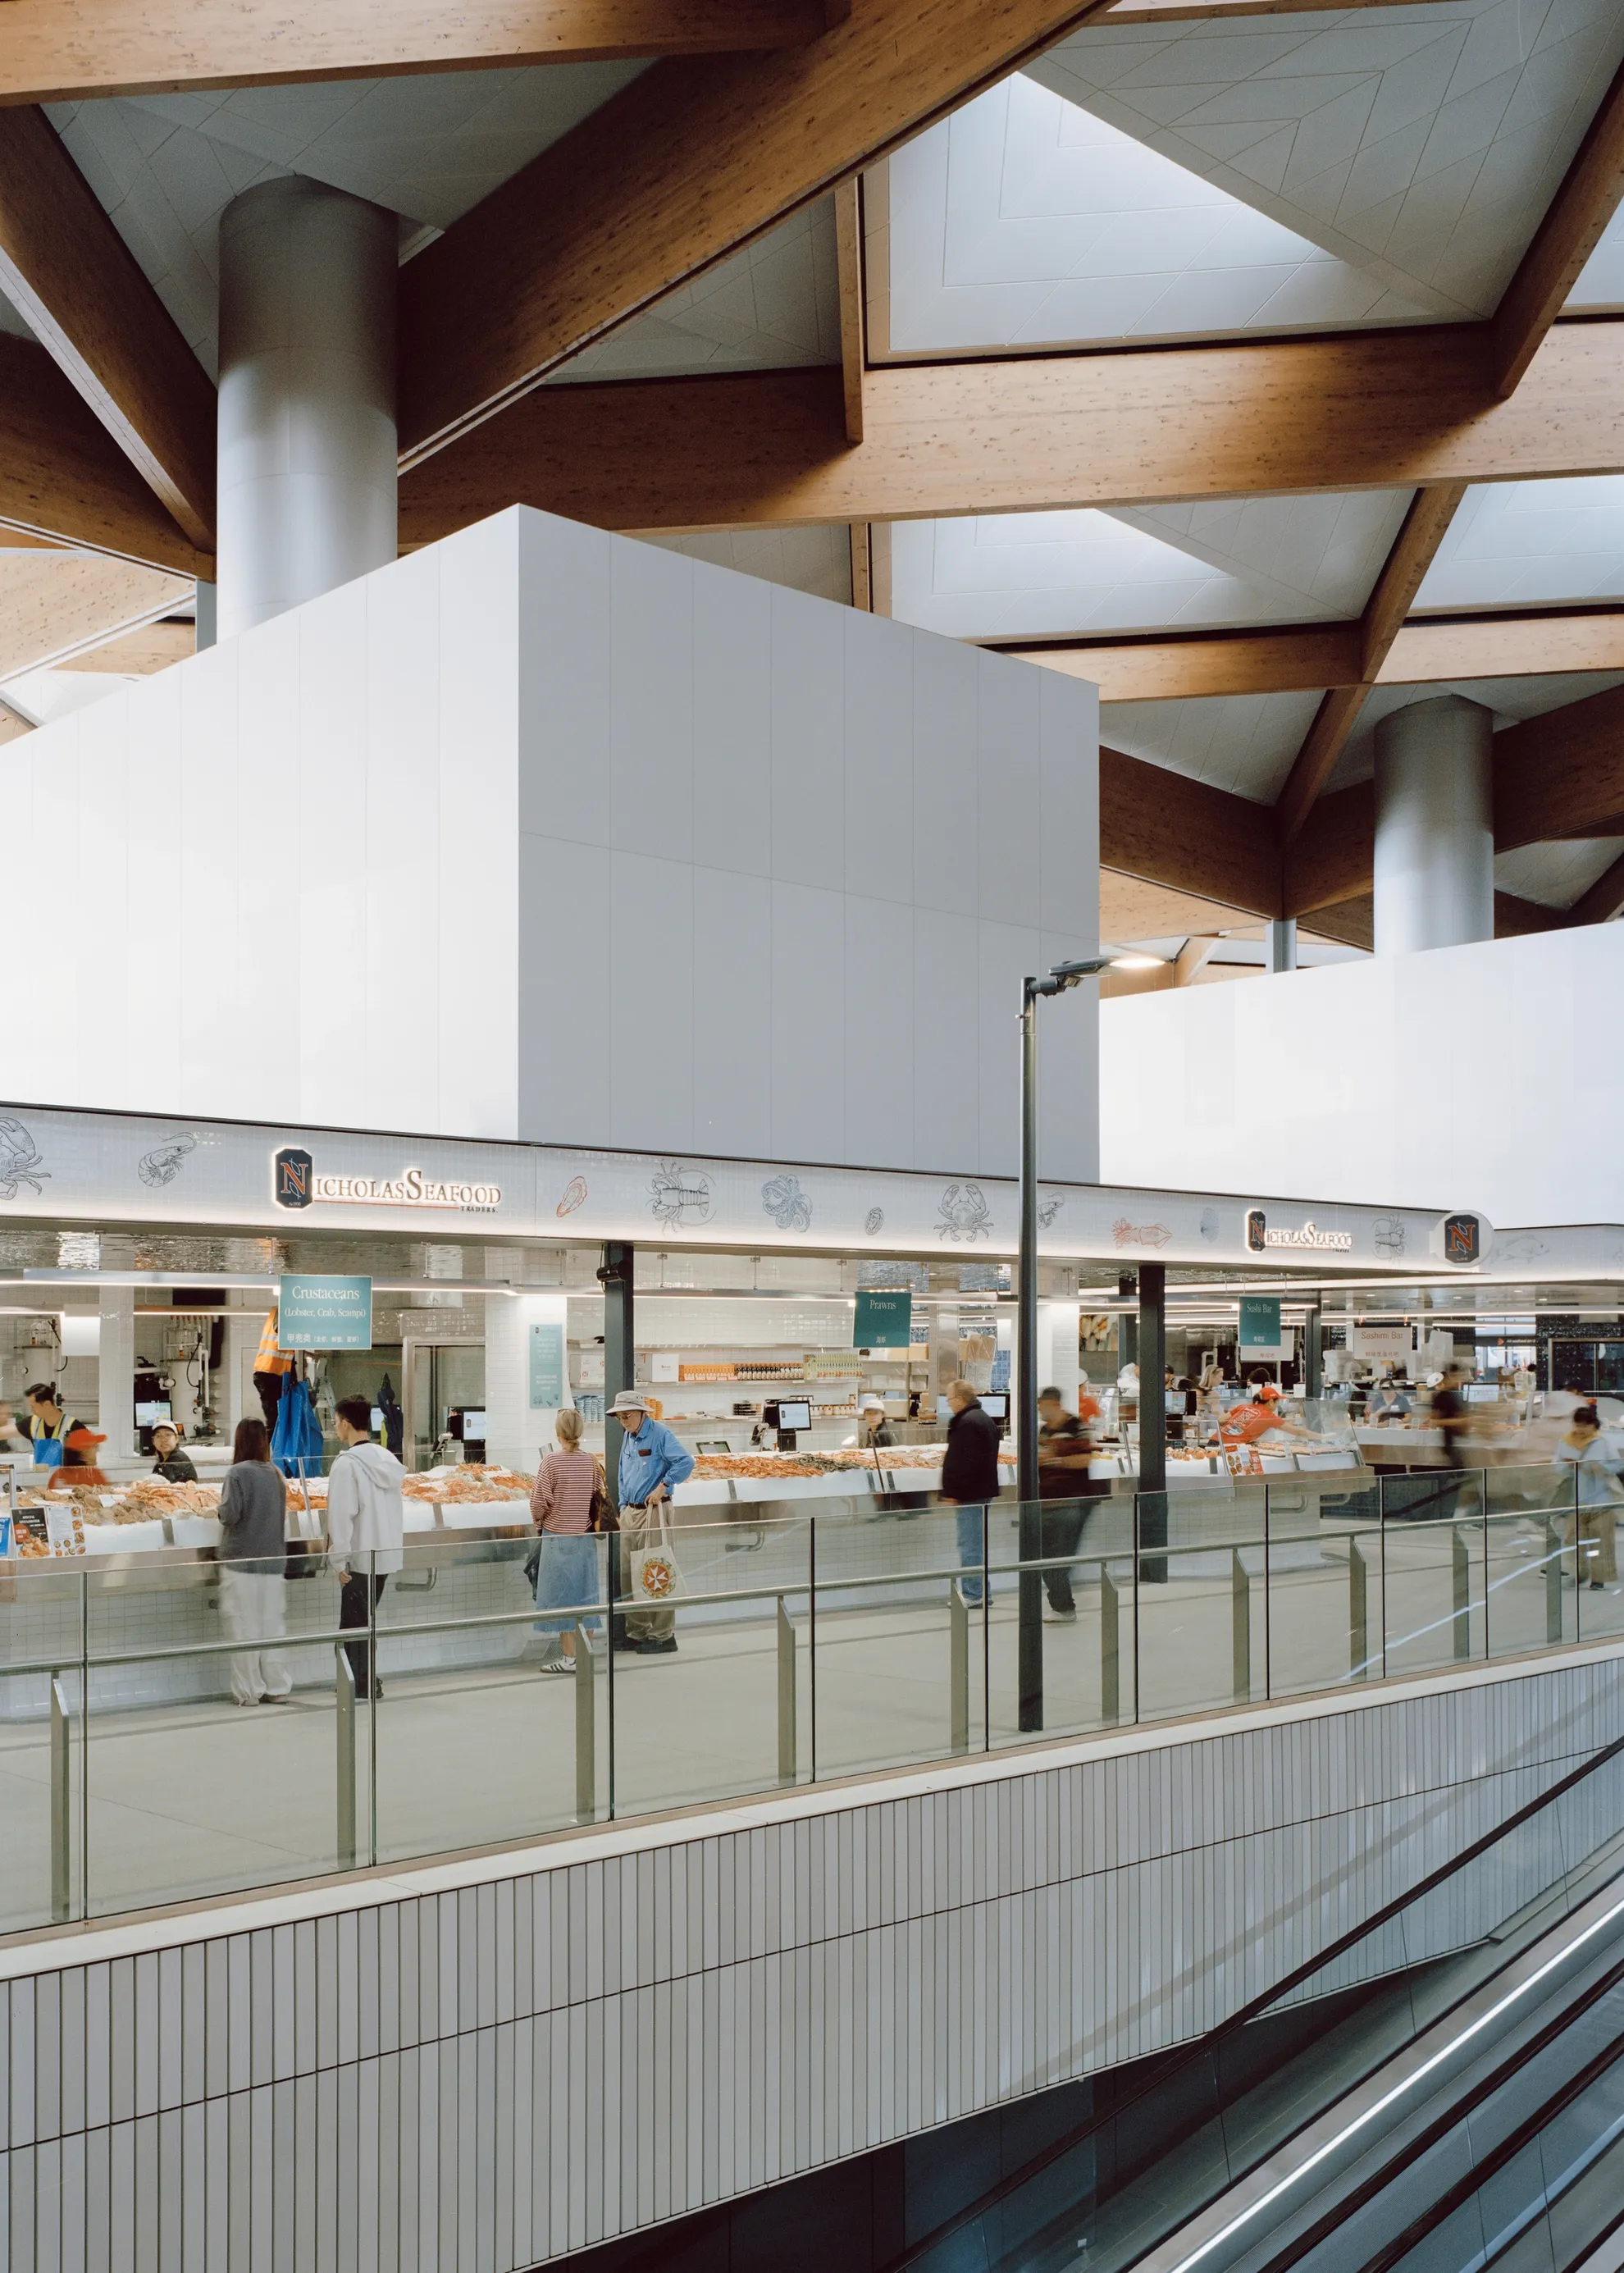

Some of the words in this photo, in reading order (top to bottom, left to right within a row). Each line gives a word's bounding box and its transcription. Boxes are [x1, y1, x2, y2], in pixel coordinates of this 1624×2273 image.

[292, 1285, 360, 1300] Crustaceans
[869, 1299, 896, 1310] Prawns
[1263, 1303, 1272, 1313] Bar
[285, 1308, 316, 1317] (Lobster,
[317, 1308, 336, 1318] Crab,
[338, 1308, 367, 1319] Scampi)
[1362, 1331, 1389, 1340] Sashimi
[1391, 1331, 1404, 1340] Bar
